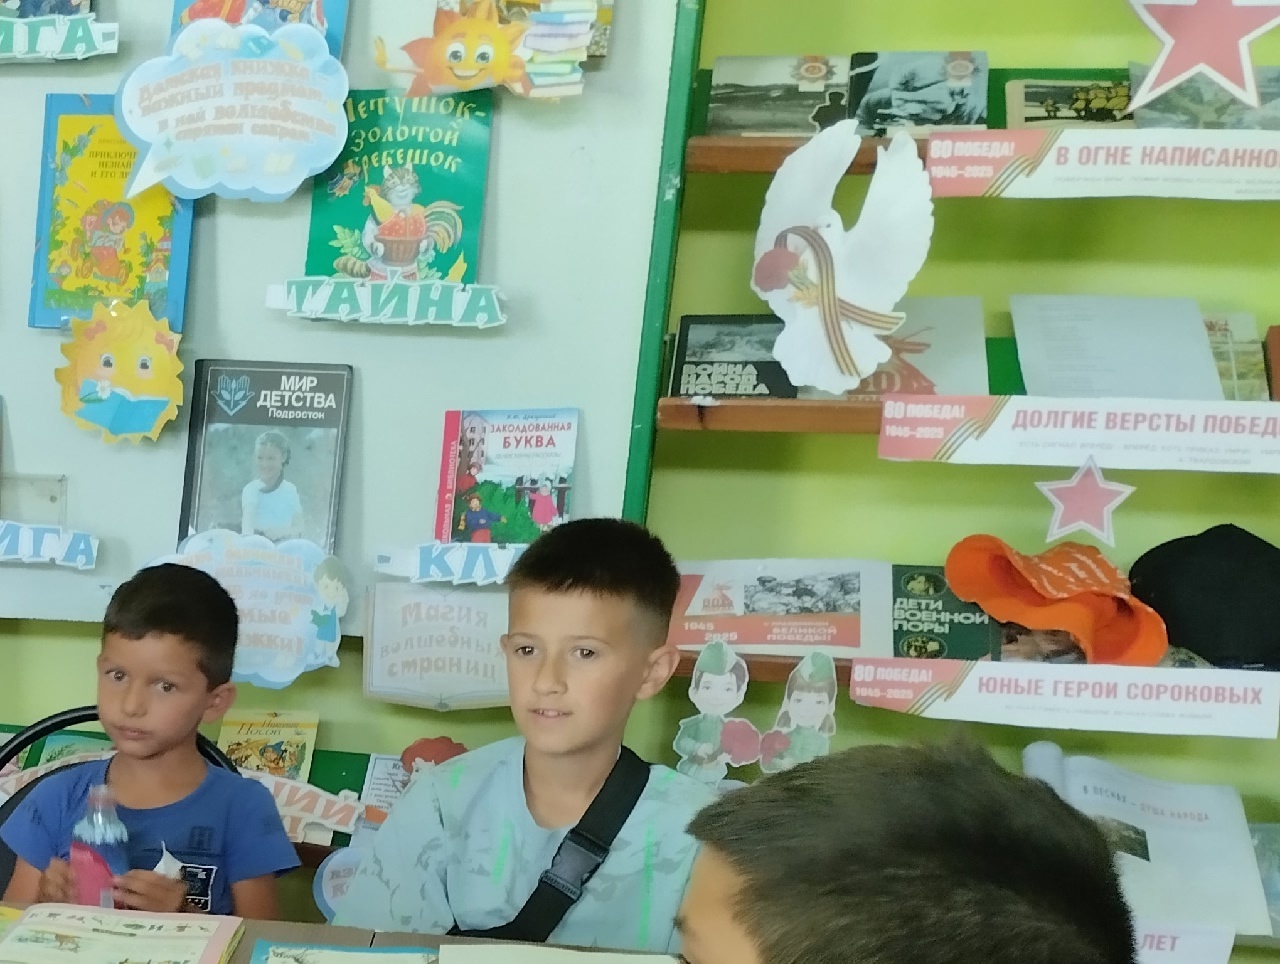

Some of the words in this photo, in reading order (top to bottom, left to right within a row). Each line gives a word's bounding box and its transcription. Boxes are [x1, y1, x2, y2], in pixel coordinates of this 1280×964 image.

[955, 140, 1015, 157] ПОБЕДА!
[1056, 146, 1070, 166] В
[1077, 146, 1133, 166] ОГНЕ
[1141, 146, 1280, 168] НАПИСАННО
[287, 268, 504, 325] ТАЙНА
[683, 361, 758, 375] ВОЙНА
[280, 375, 318, 391] МИР
[681, 374, 758, 385] НАРОД
[680, 383, 770, 395] ПОБЕДА
[257, 391, 337, 410] ДЕТСТВА
[268, 407, 325, 420] Подросток
[906, 404, 965, 418] ПОБЕДА!
[491, 422, 572, 433] ЗАКОЛДОВАННАЯ
[1012, 409, 1099, 431] ДОЛГИЕ
[1104, 411, 1194, 433] ВЕРСТЫ
[1202, 414, 1280, 438] ПОБЕД
[503, 435, 556, 449] БУКВА
[894, 598, 943, 610] ДЕТИ
[893, 608, 989, 625] ВОЕННОЙ
[893, 620, 949, 634] ПОРЫ
[876, 669, 932, 683] ПОБЕДА!
[978, 676, 1045, 696] ЮНЫЕ
[1052, 680, 1119, 700] ГЕРОИ
[1126, 681, 1263, 705] СОРОКОВЫХ
[1141, 933, 1180, 952] ЛЕТ
